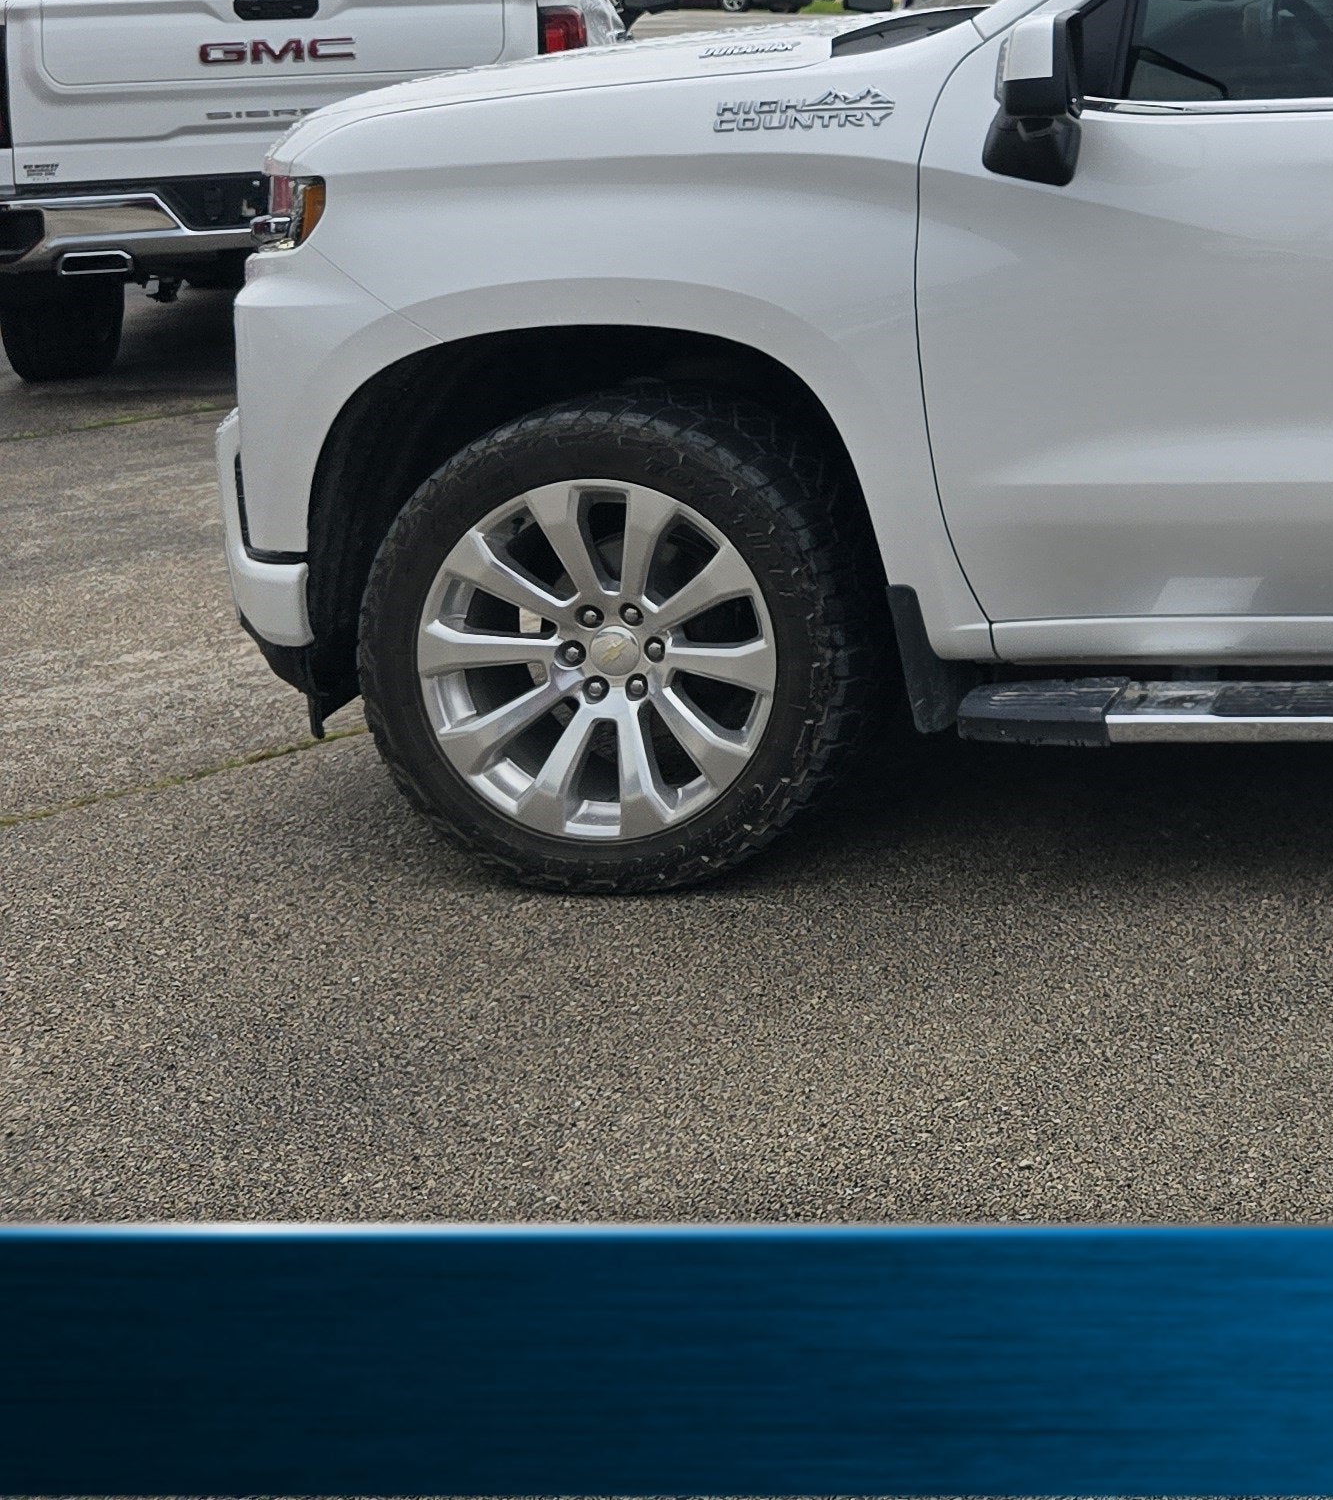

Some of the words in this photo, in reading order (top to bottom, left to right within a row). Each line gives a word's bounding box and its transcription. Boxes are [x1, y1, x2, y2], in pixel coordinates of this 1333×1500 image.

[199, 37, 357, 66] GMC
[699, 41, 801, 59] DURAMAX
[716, 99, 807, 116] HIGH
[713, 111, 895, 133] COUNTRY
